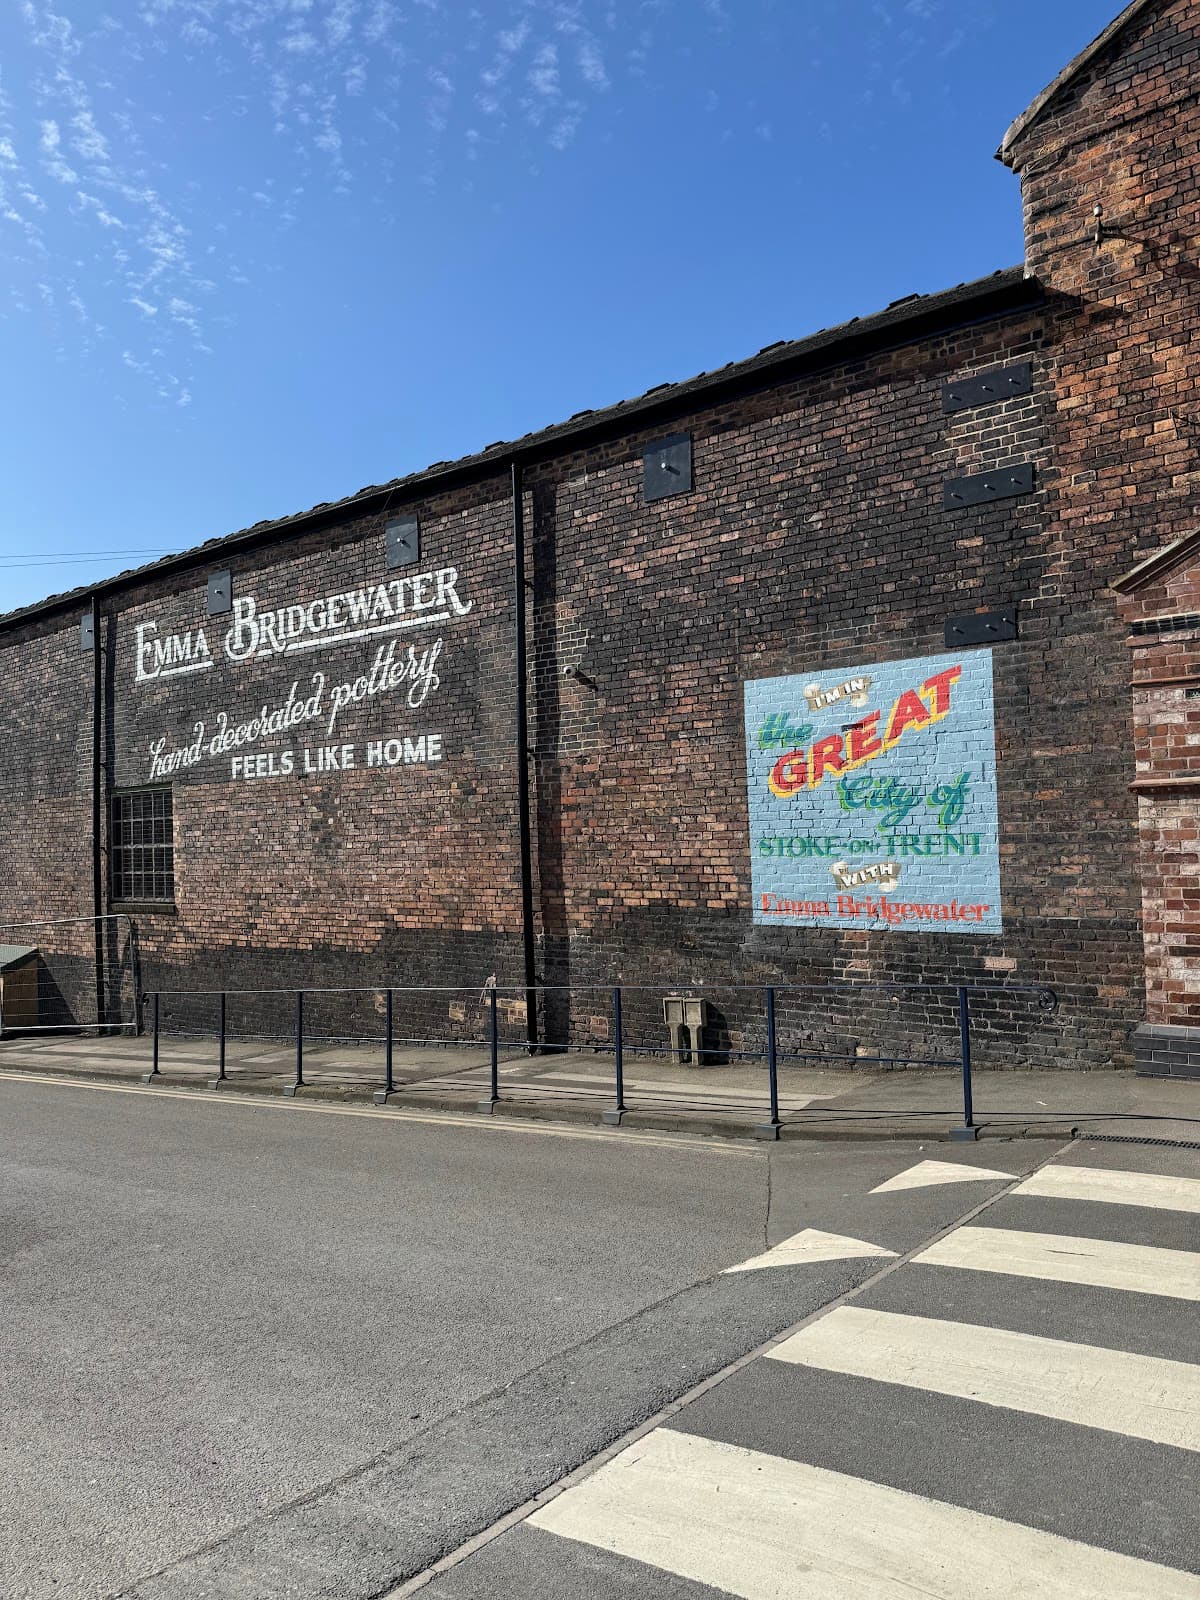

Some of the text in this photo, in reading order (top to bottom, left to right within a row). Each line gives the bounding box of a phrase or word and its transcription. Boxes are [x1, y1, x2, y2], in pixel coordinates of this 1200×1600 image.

[134, 566, 473, 682] EMMA BRIDGEWATER
[326, 637, 443, 736] pottery
[814, 678, 865, 709] I'M IN
[758, 711, 814, 749] the
[768, 665, 962, 798] GREAT
[231, 733, 443, 780] FEELS LIKE HOME
[836, 771, 972, 832] City of
[882, 833, 982, 857] TRENT
[840, 863, 894, 888] WITH
[761, 893, 990, 926] Emma Bridgewater
